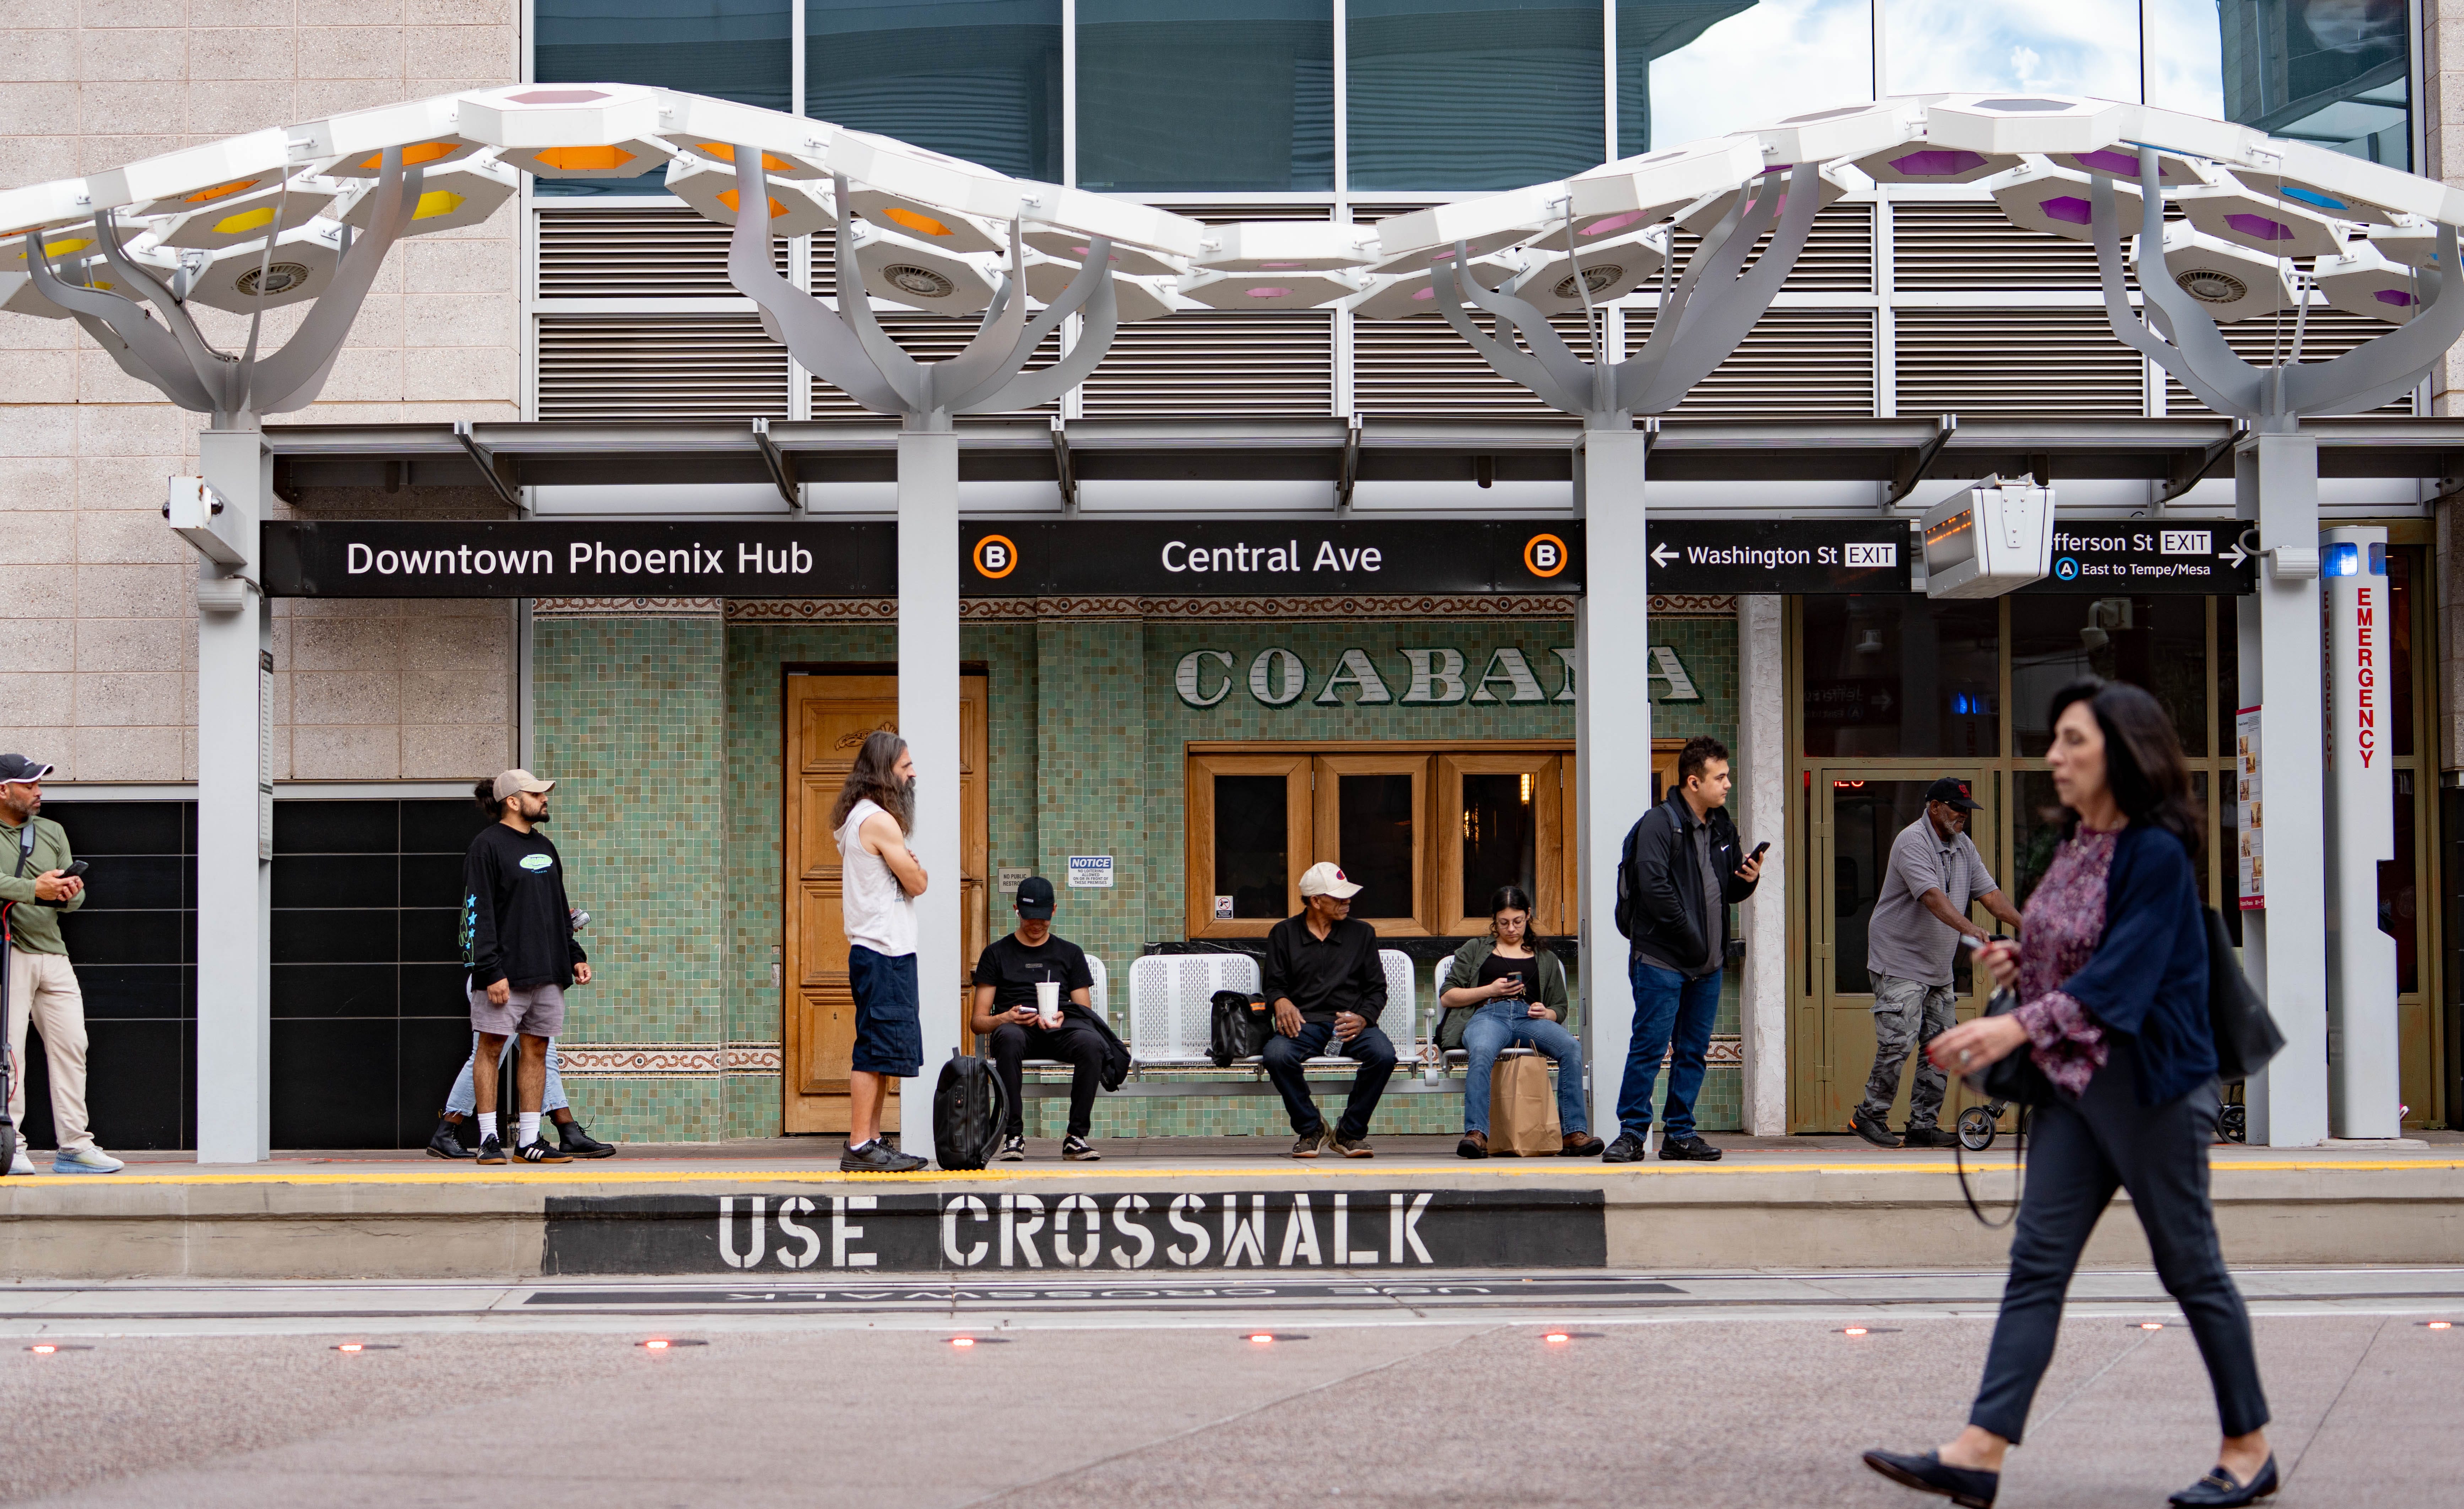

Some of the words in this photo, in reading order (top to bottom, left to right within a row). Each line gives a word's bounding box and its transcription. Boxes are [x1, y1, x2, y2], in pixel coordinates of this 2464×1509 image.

[2052, 532, 2125, 551] fferson
[2133, 534, 2153, 551] St
[2165, 534, 2208, 551] EXIT
[348, 543, 552, 574] Downtown
[570, 541, 724, 574] Phoenix
[739, 541, 812, 573] Hub
[987, 546, 1005, 567] B
[1162, 540, 1300, 572] Central
[1313, 541, 1381, 571] Ave
[1537, 546, 1556, 566] B
[1687, 546, 1810, 569] Washington
[1818, 546, 1837, 564] St
[1850, 547, 1892, 563] EXIT
[2061, 563, 2073, 574] A
[2083, 564, 2109, 575] East
[2112, 564, 2126, 575] to
[2129, 563, 2210, 578] Tempe/Mesa
[2323, 591, 2333, 772] EMERGENCY
[2357, 588, 2374, 768] EMERGENCY
[1072, 859, 1110, 867] NOTICE
[719, 1195, 877, 1269] USE
[942, 1194, 1434, 1268] CROSSWALK
[725, 1288, 1276, 1300] CROSSWALK
